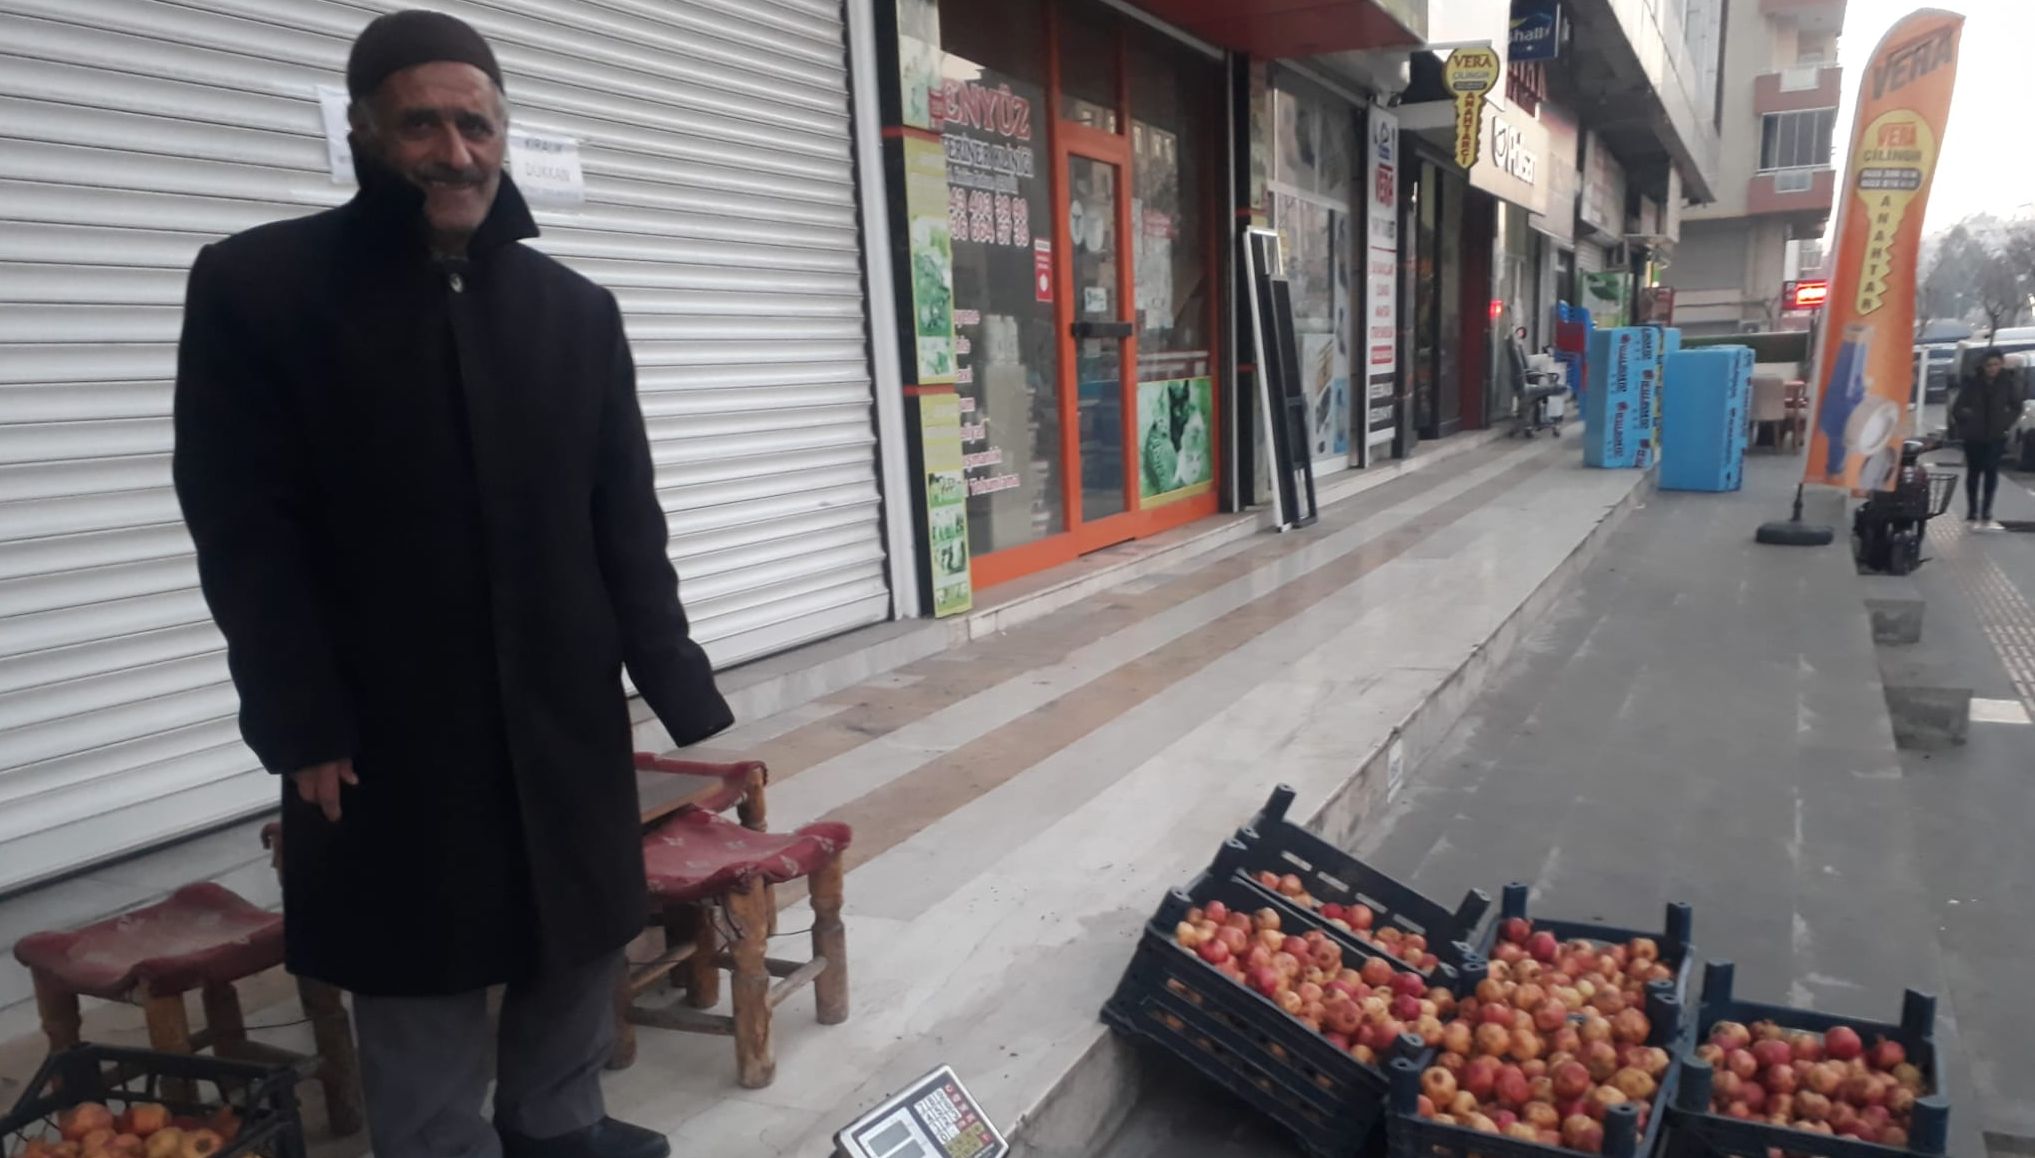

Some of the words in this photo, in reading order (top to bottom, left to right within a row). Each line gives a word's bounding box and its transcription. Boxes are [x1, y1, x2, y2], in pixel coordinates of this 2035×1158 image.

[1454, 54, 1492, 68] VERA
[1873, 26, 1954, 101] VERA
[931, 79, 1031, 140] ENYÜZ
[1878, 121, 1917, 146] VERA
[1861, 195, 1891, 310] ANAHTAR
